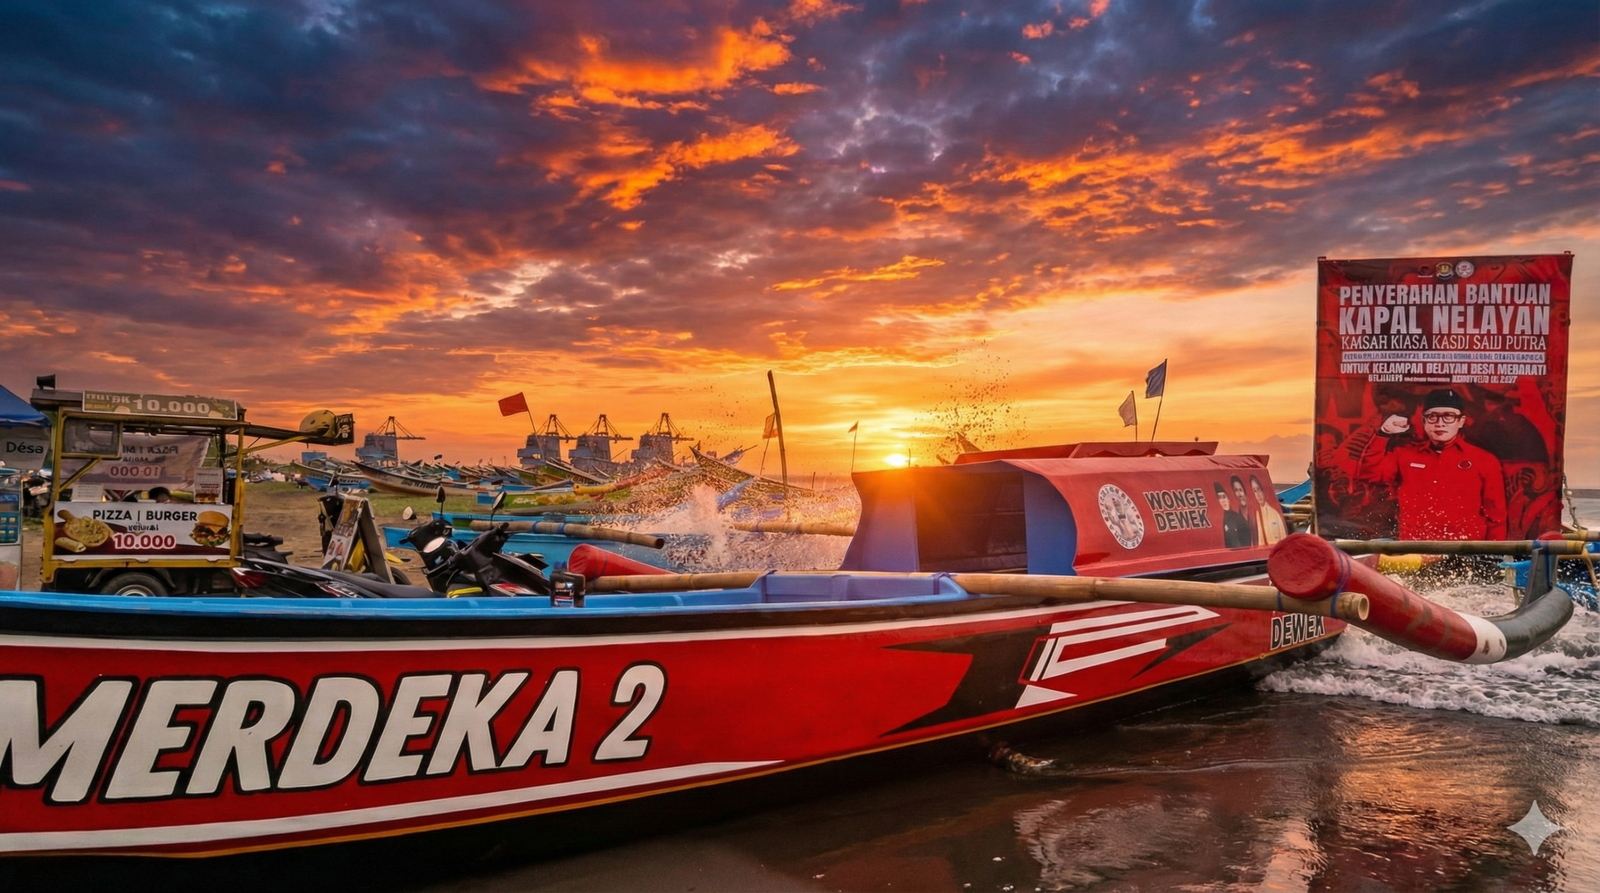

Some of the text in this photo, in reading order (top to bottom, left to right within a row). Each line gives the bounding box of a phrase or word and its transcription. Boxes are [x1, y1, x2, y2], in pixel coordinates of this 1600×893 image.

[1340, 283, 1550, 306] PENYERAHAN BANTUAN
[1340, 305, 1550, 336] KAPAL NELAYAN
[1505, 335, 1547, 350] PUTRA
[134, 398, 210, 415] 10.000
[6, 441, 44, 454] Désa
[1143, 488, 1208, 511] WONGE
[92, 509, 132, 521] PIZZA
[146, 510, 198, 521] BURGER
[1153, 509, 1212, 532] DEWEK
[113, 534, 177, 549] 10.000
[0, 663, 667, 803] MERDEKA 2
